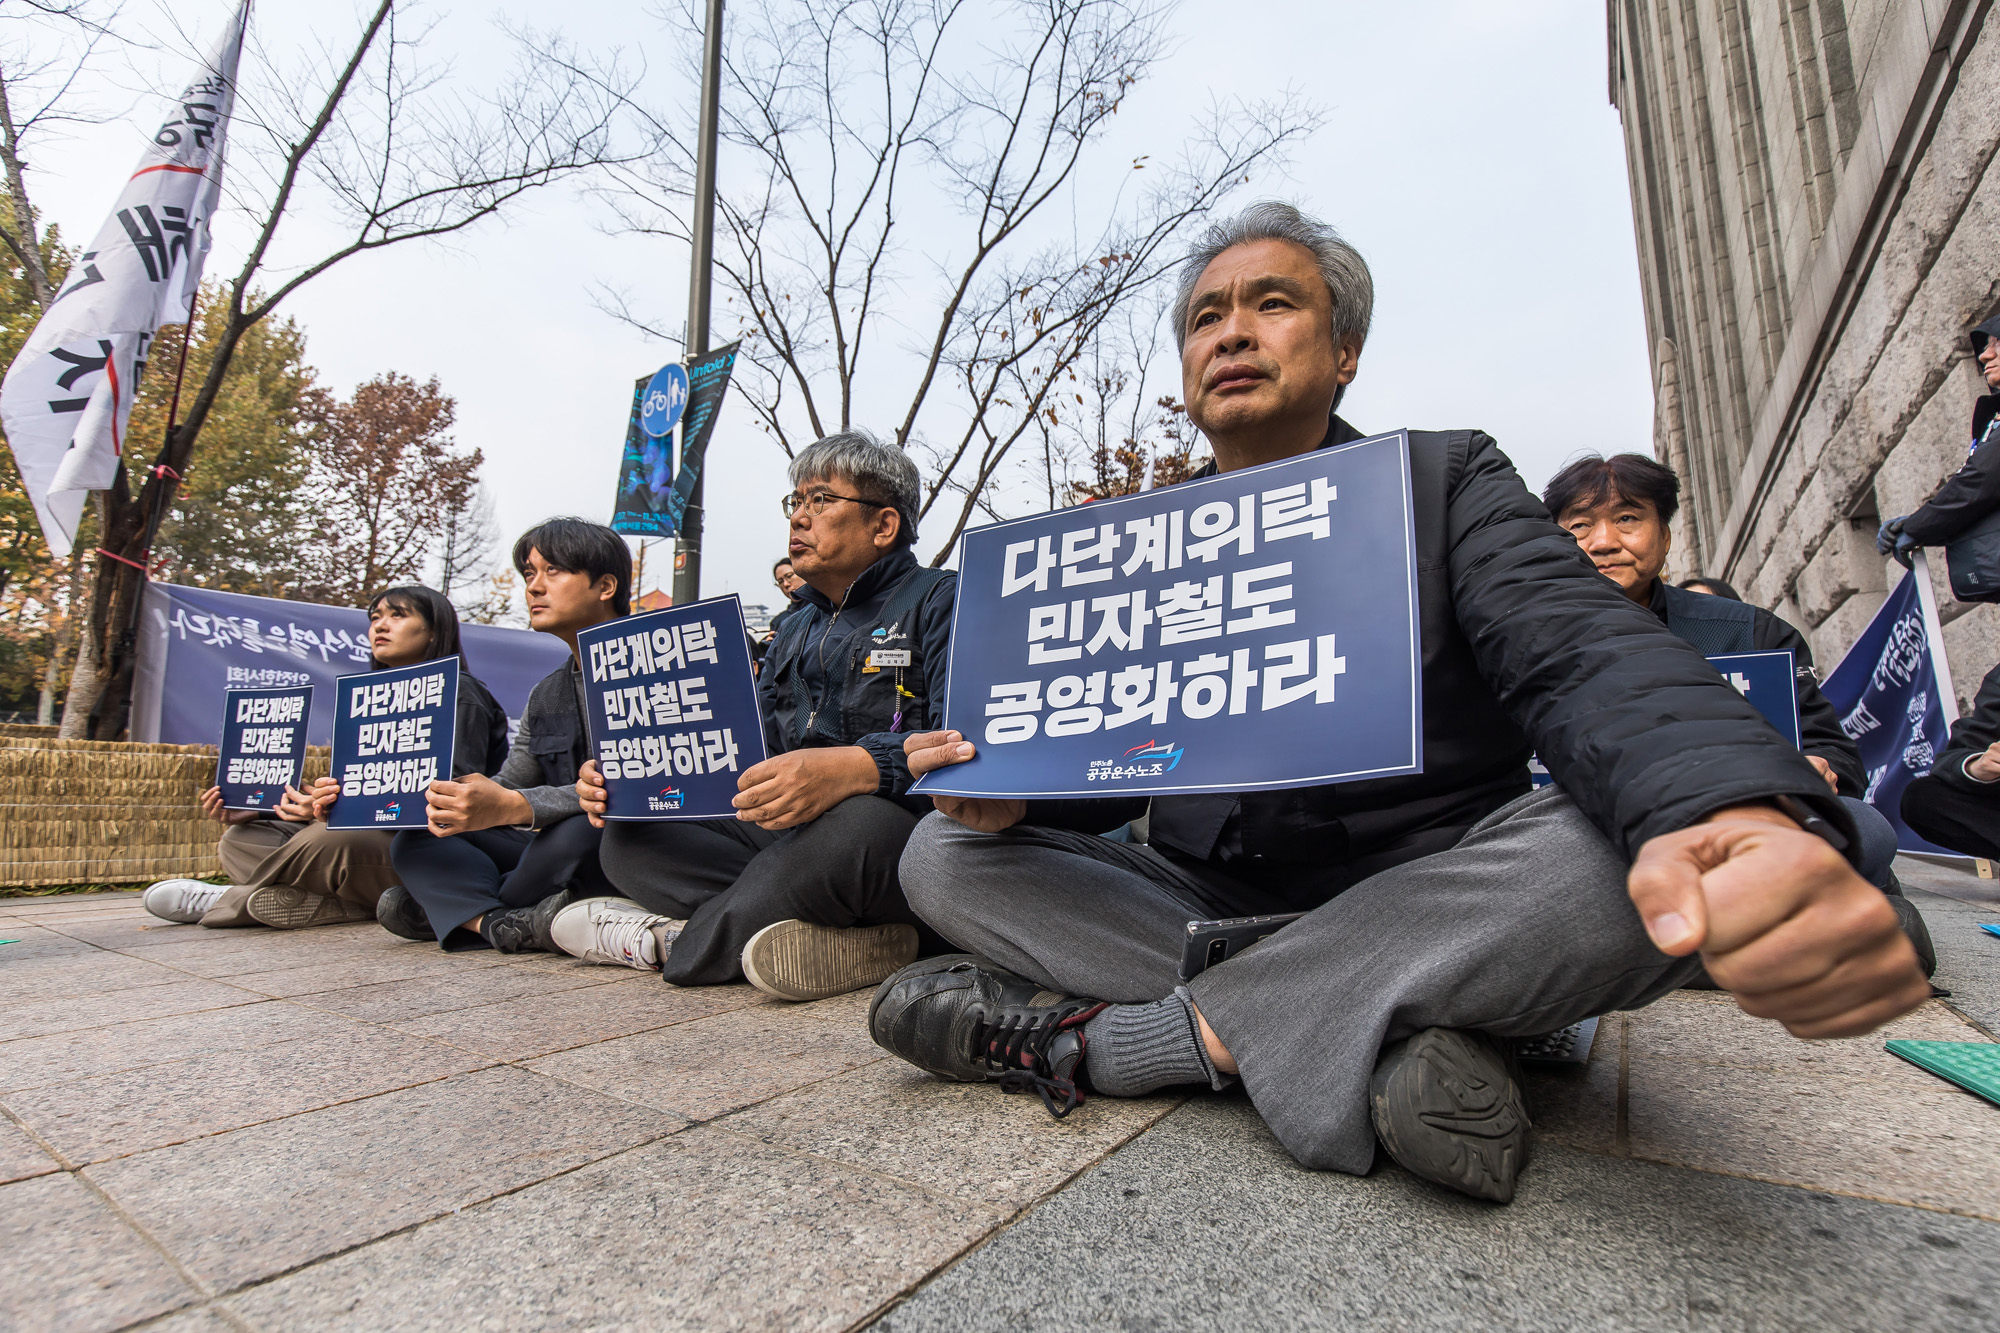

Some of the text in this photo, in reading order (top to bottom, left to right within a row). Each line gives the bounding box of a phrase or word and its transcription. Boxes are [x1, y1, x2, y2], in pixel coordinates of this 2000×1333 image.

[690, 355, 726, 380] Unfold
[1002, 477, 1337, 597] 다단계위탁
[1028, 562, 1295, 665] 민자철도
[590, 620, 717, 682] 다단계위탁
[236, 696, 304, 723] 다단계위탁
[351, 673, 444, 718] 다단계위탁
[604, 677, 712, 730] 민자철도
[985, 634, 1345, 744] 공영화하라
[240, 728, 294, 753] 민자철도
[358, 716, 432, 756] 민자철도
[600, 728, 738, 780] 공영화하라
[227, 759, 294, 785] 공영화하라
[343, 757, 437, 797] 공영화하라
[1086, 763, 1163, 781] 공공운수노조
